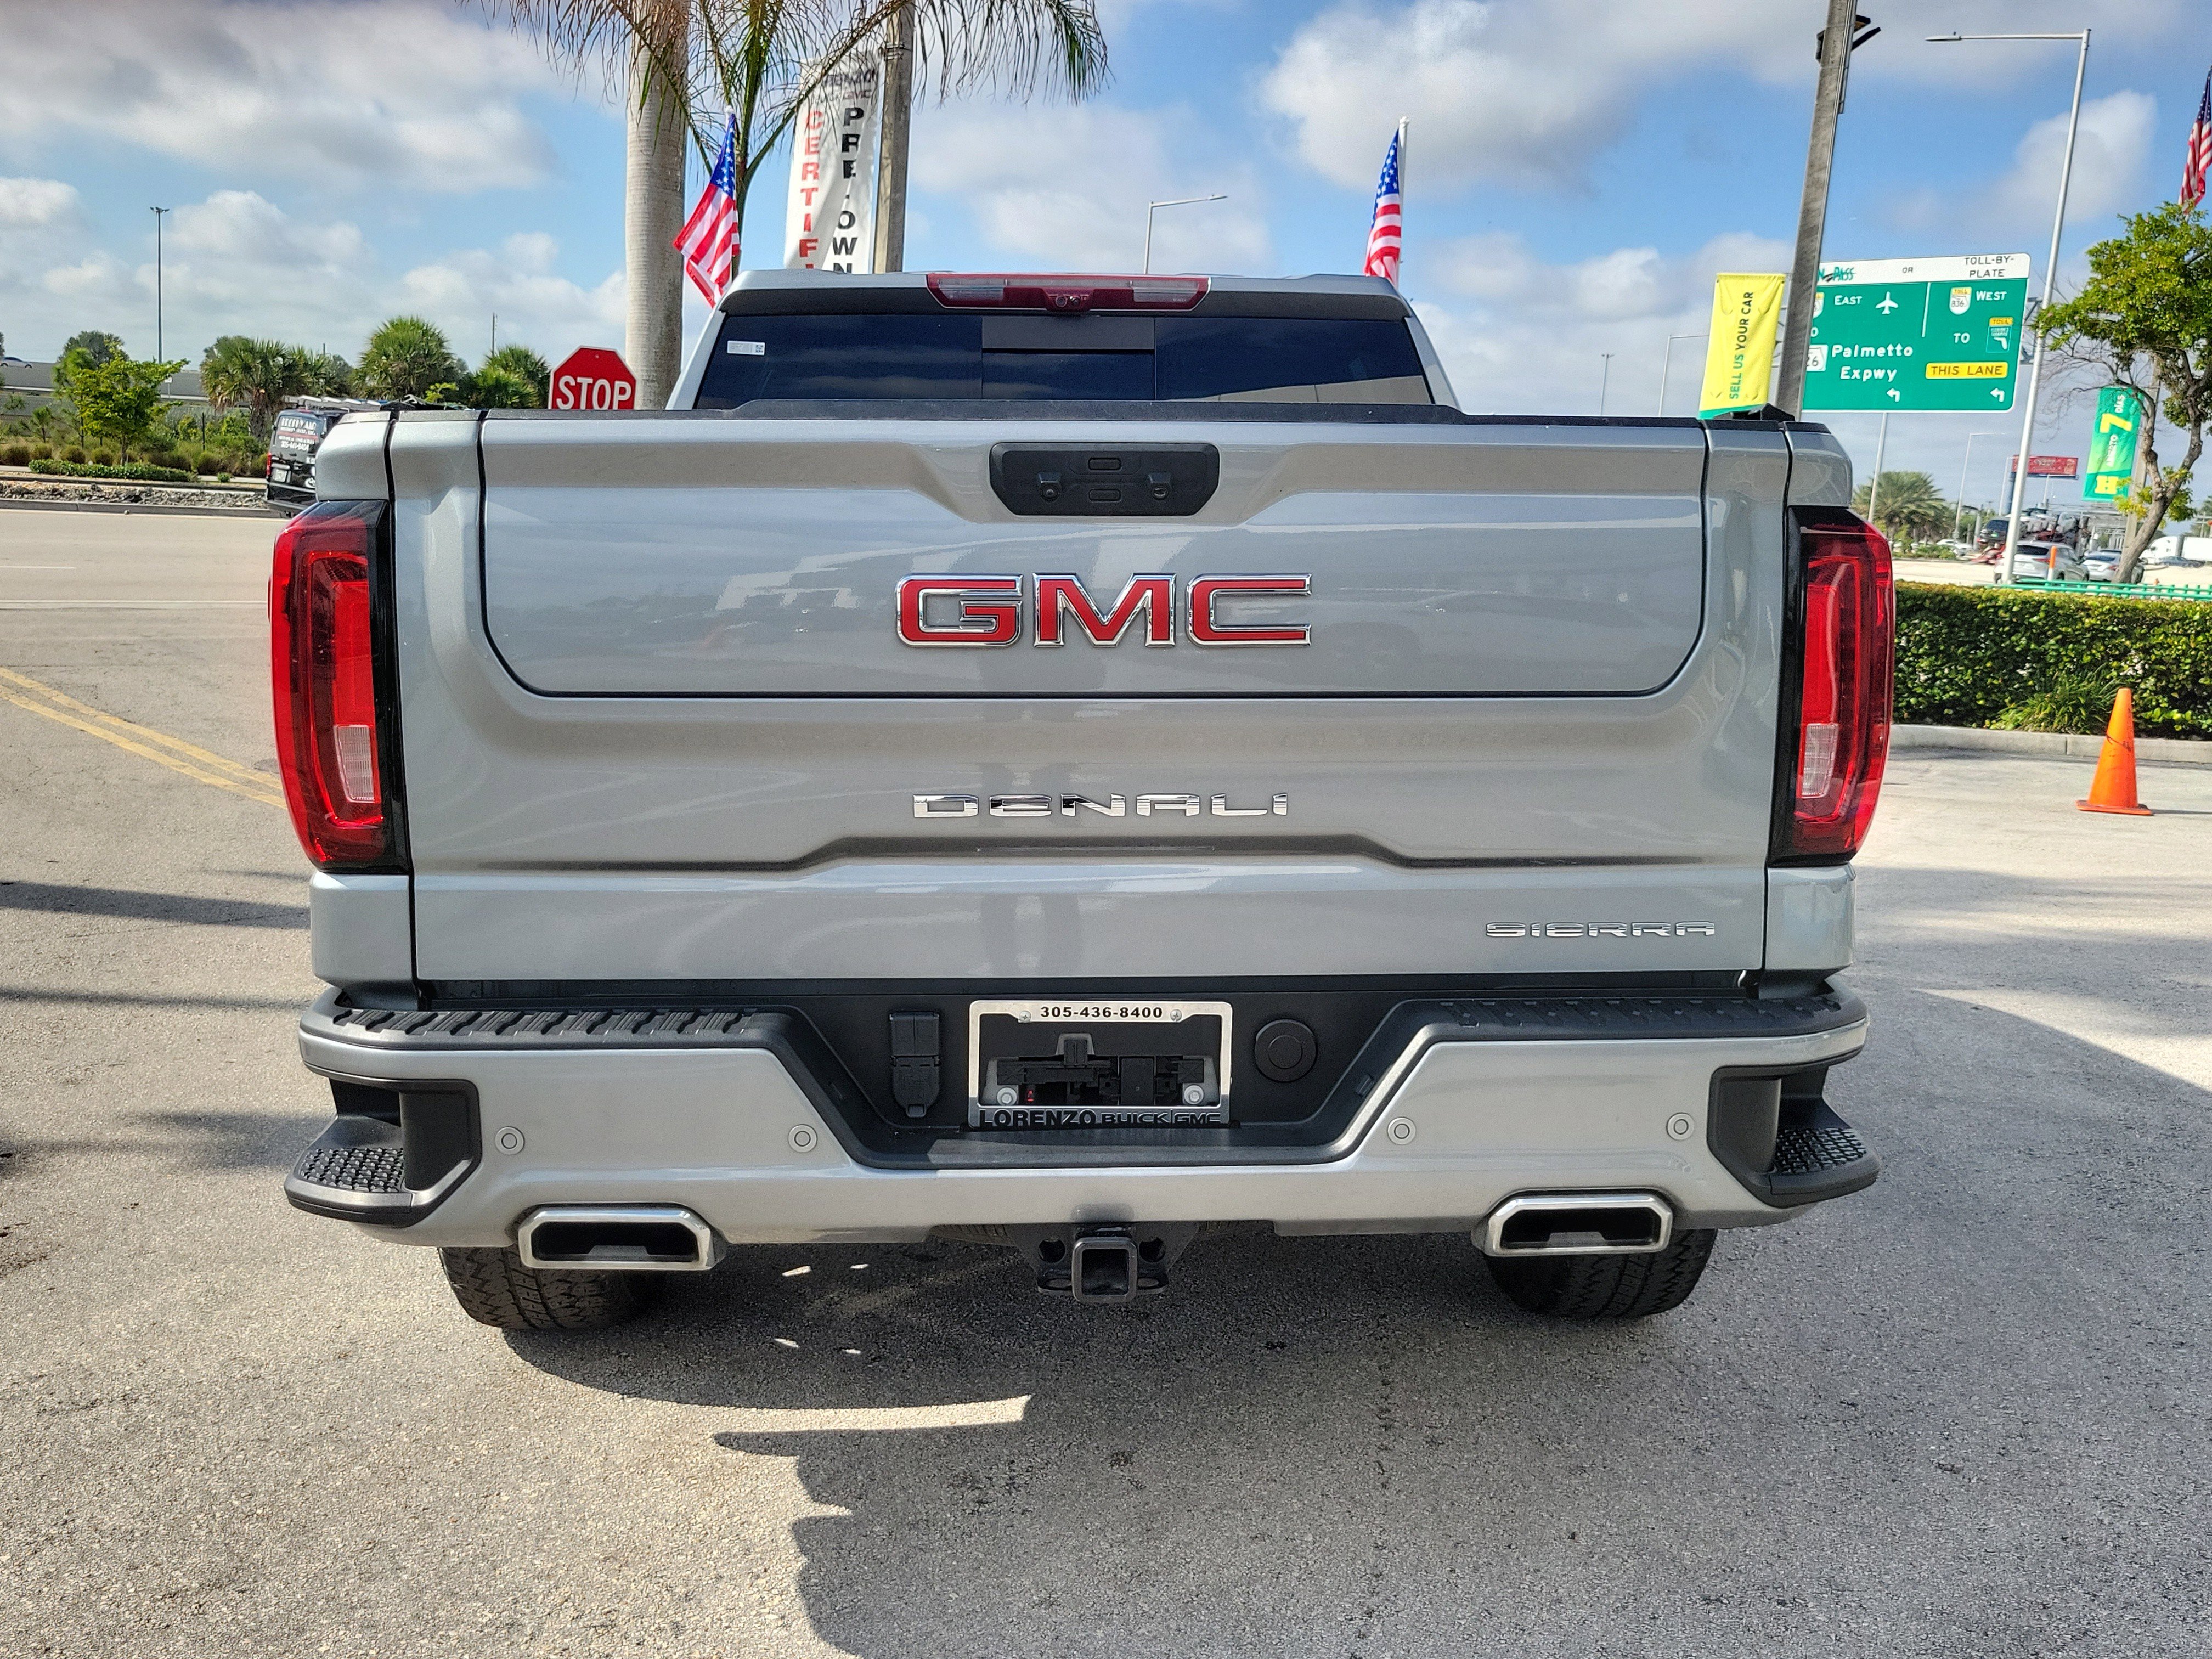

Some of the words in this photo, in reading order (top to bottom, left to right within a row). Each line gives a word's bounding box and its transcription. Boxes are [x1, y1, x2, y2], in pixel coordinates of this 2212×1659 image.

[799, 110, 823, 268] CERTIF
[1969, 269, 2005, 278] PLATE
[1741, 292, 1754, 315] CAR
[1834, 294, 1863, 306] EAST
[1951, 300, 1965, 308] 836
[1976, 290, 2007, 301] WEST
[1735, 318, 1750, 351] YOUR
[1953, 332, 1971, 343] TO
[1831, 343, 1914, 358] Palmetto
[1733, 354, 1745, 369] US
[1840, 365, 1898, 382] Expwy
[1931, 366, 1960, 376] THIS
[1967, 365, 2004, 375] LANE
[556, 375, 631, 410] STOP
[1729, 373, 1742, 399] SELL
[2099, 413, 2133, 433] 7
[895, 572, 1312, 647] GMC
[913, 793, 1288, 818] DENALI
[1486, 921, 1716, 938] SIERRA
[1040, 1006, 1163, 1018] 305-436-8400
[979, 1109, 1097, 1127] LORENZO
[1101, 1112, 1169, 1125] BUICK
[1173, 1113, 1221, 1125] GMC
